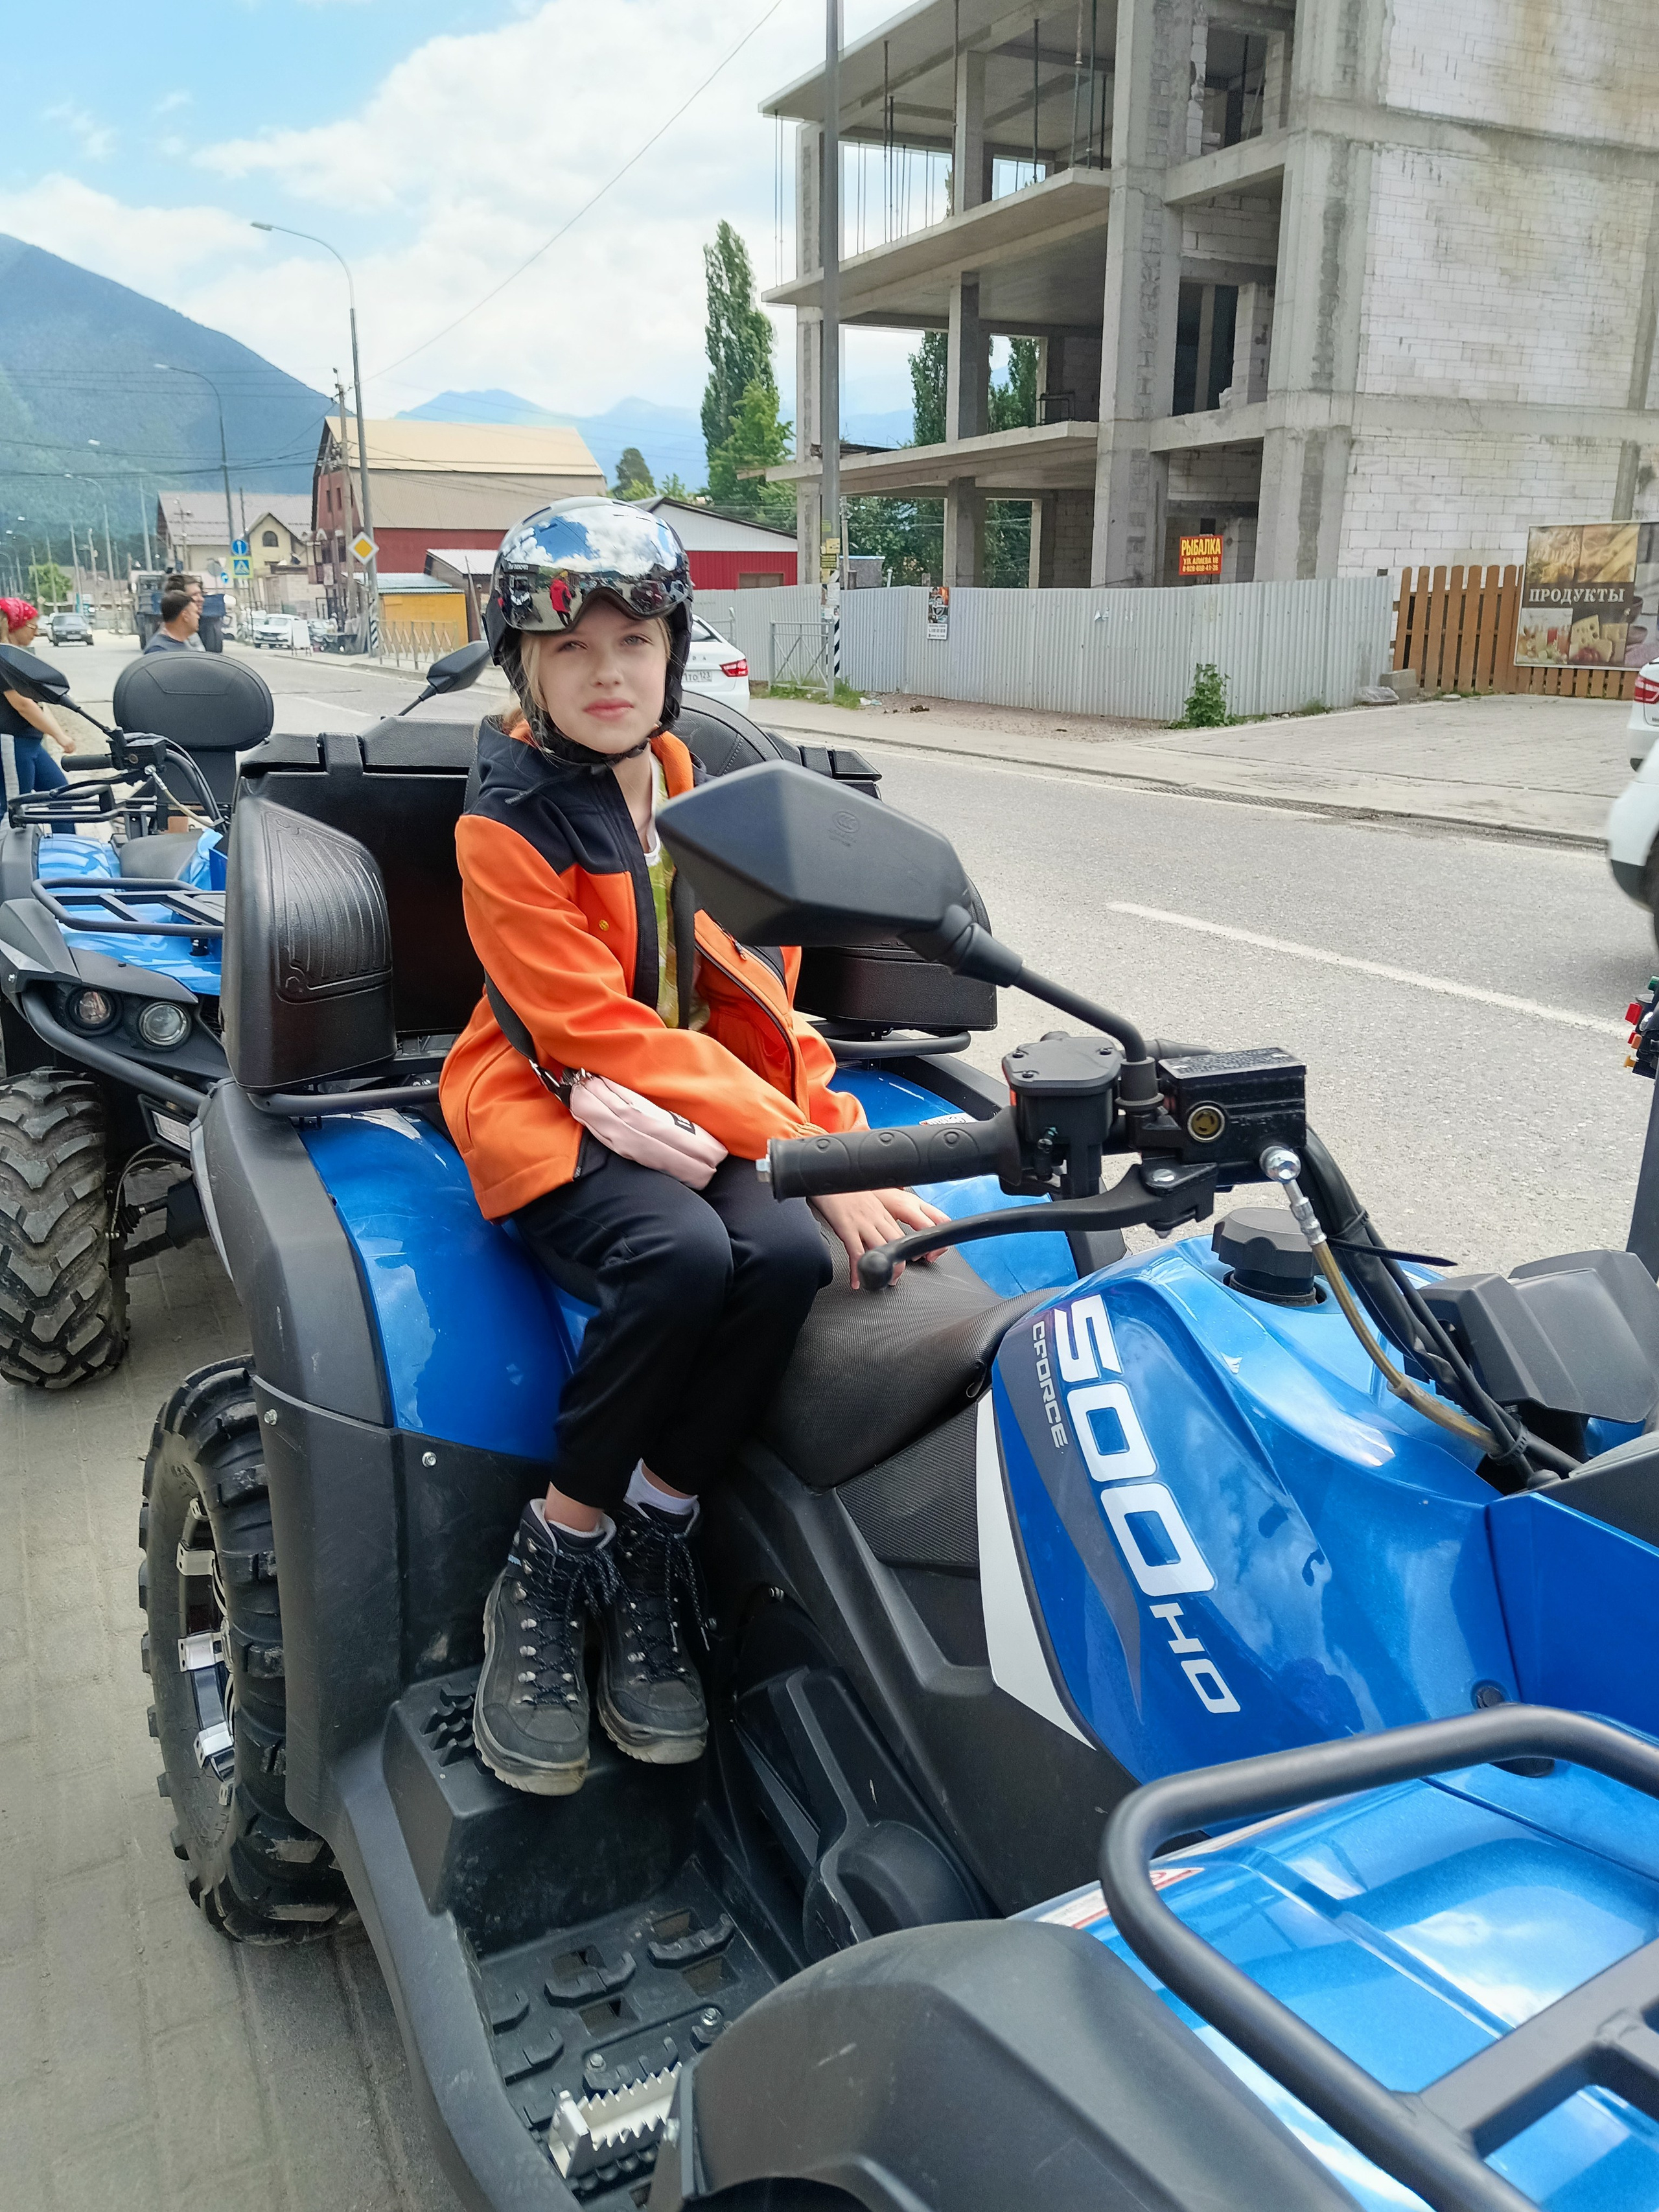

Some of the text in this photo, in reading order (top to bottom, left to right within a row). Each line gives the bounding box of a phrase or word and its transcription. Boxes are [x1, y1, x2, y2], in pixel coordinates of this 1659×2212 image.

[1181, 538, 1221, 556] РЫБАЛКА
[1529, 588, 1625, 605] ПРОДУКТЫ
[1032, 1320, 1069, 1449] CFORCE
[1054, 1294, 1242, 1714] 500 HO
